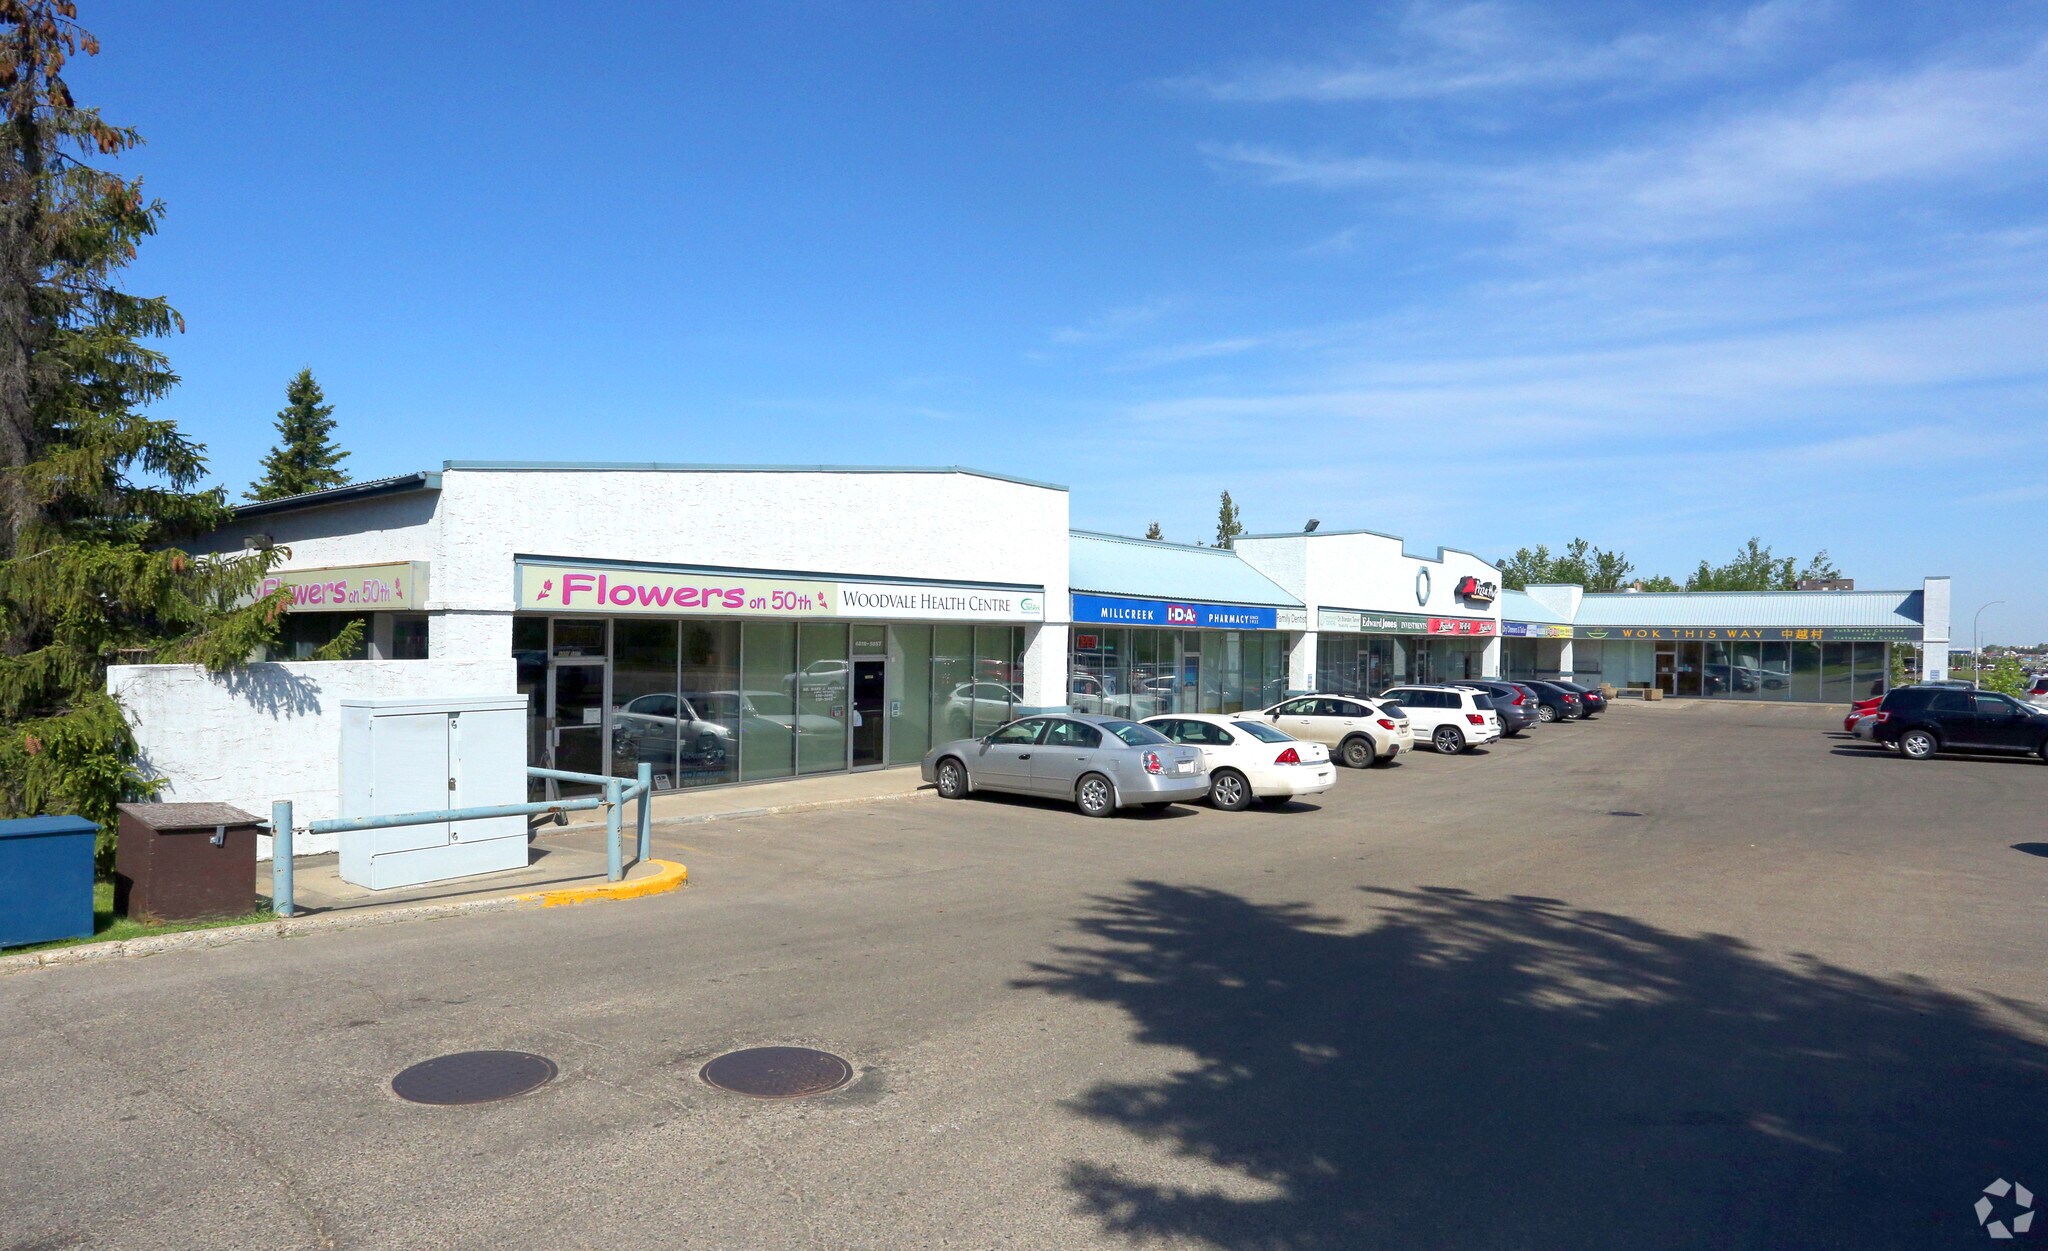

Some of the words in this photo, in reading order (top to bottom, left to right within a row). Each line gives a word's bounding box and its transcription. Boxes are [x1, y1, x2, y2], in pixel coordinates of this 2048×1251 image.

[263, 577, 347, 605] Fwers
[348, 590, 360, 604] on
[362, 579, 392, 604] 50th
[562, 573, 745, 608] Flowers
[749, 599, 767, 610] on
[771, 590, 812, 611] 50th
[843, 590, 917, 609] WOODVALE
[920, 594, 966, 611] HEALTH
[968, 596, 1011, 612] CENTRE
[1100, 607, 1154, 620] MILLCREEK
[1208, 613, 1249, 624] PHARMACY
[1277, 613, 1291, 625] Family
[1362, 616, 1382, 628] Edward
[1382, 618, 1398, 630] Jones
[1622, 629, 1661, 638] WOK
[1672, 629, 1717, 639] THIS
[1727, 629, 1764, 639] WAY
[1781, 628, 1824, 640] 中越村
